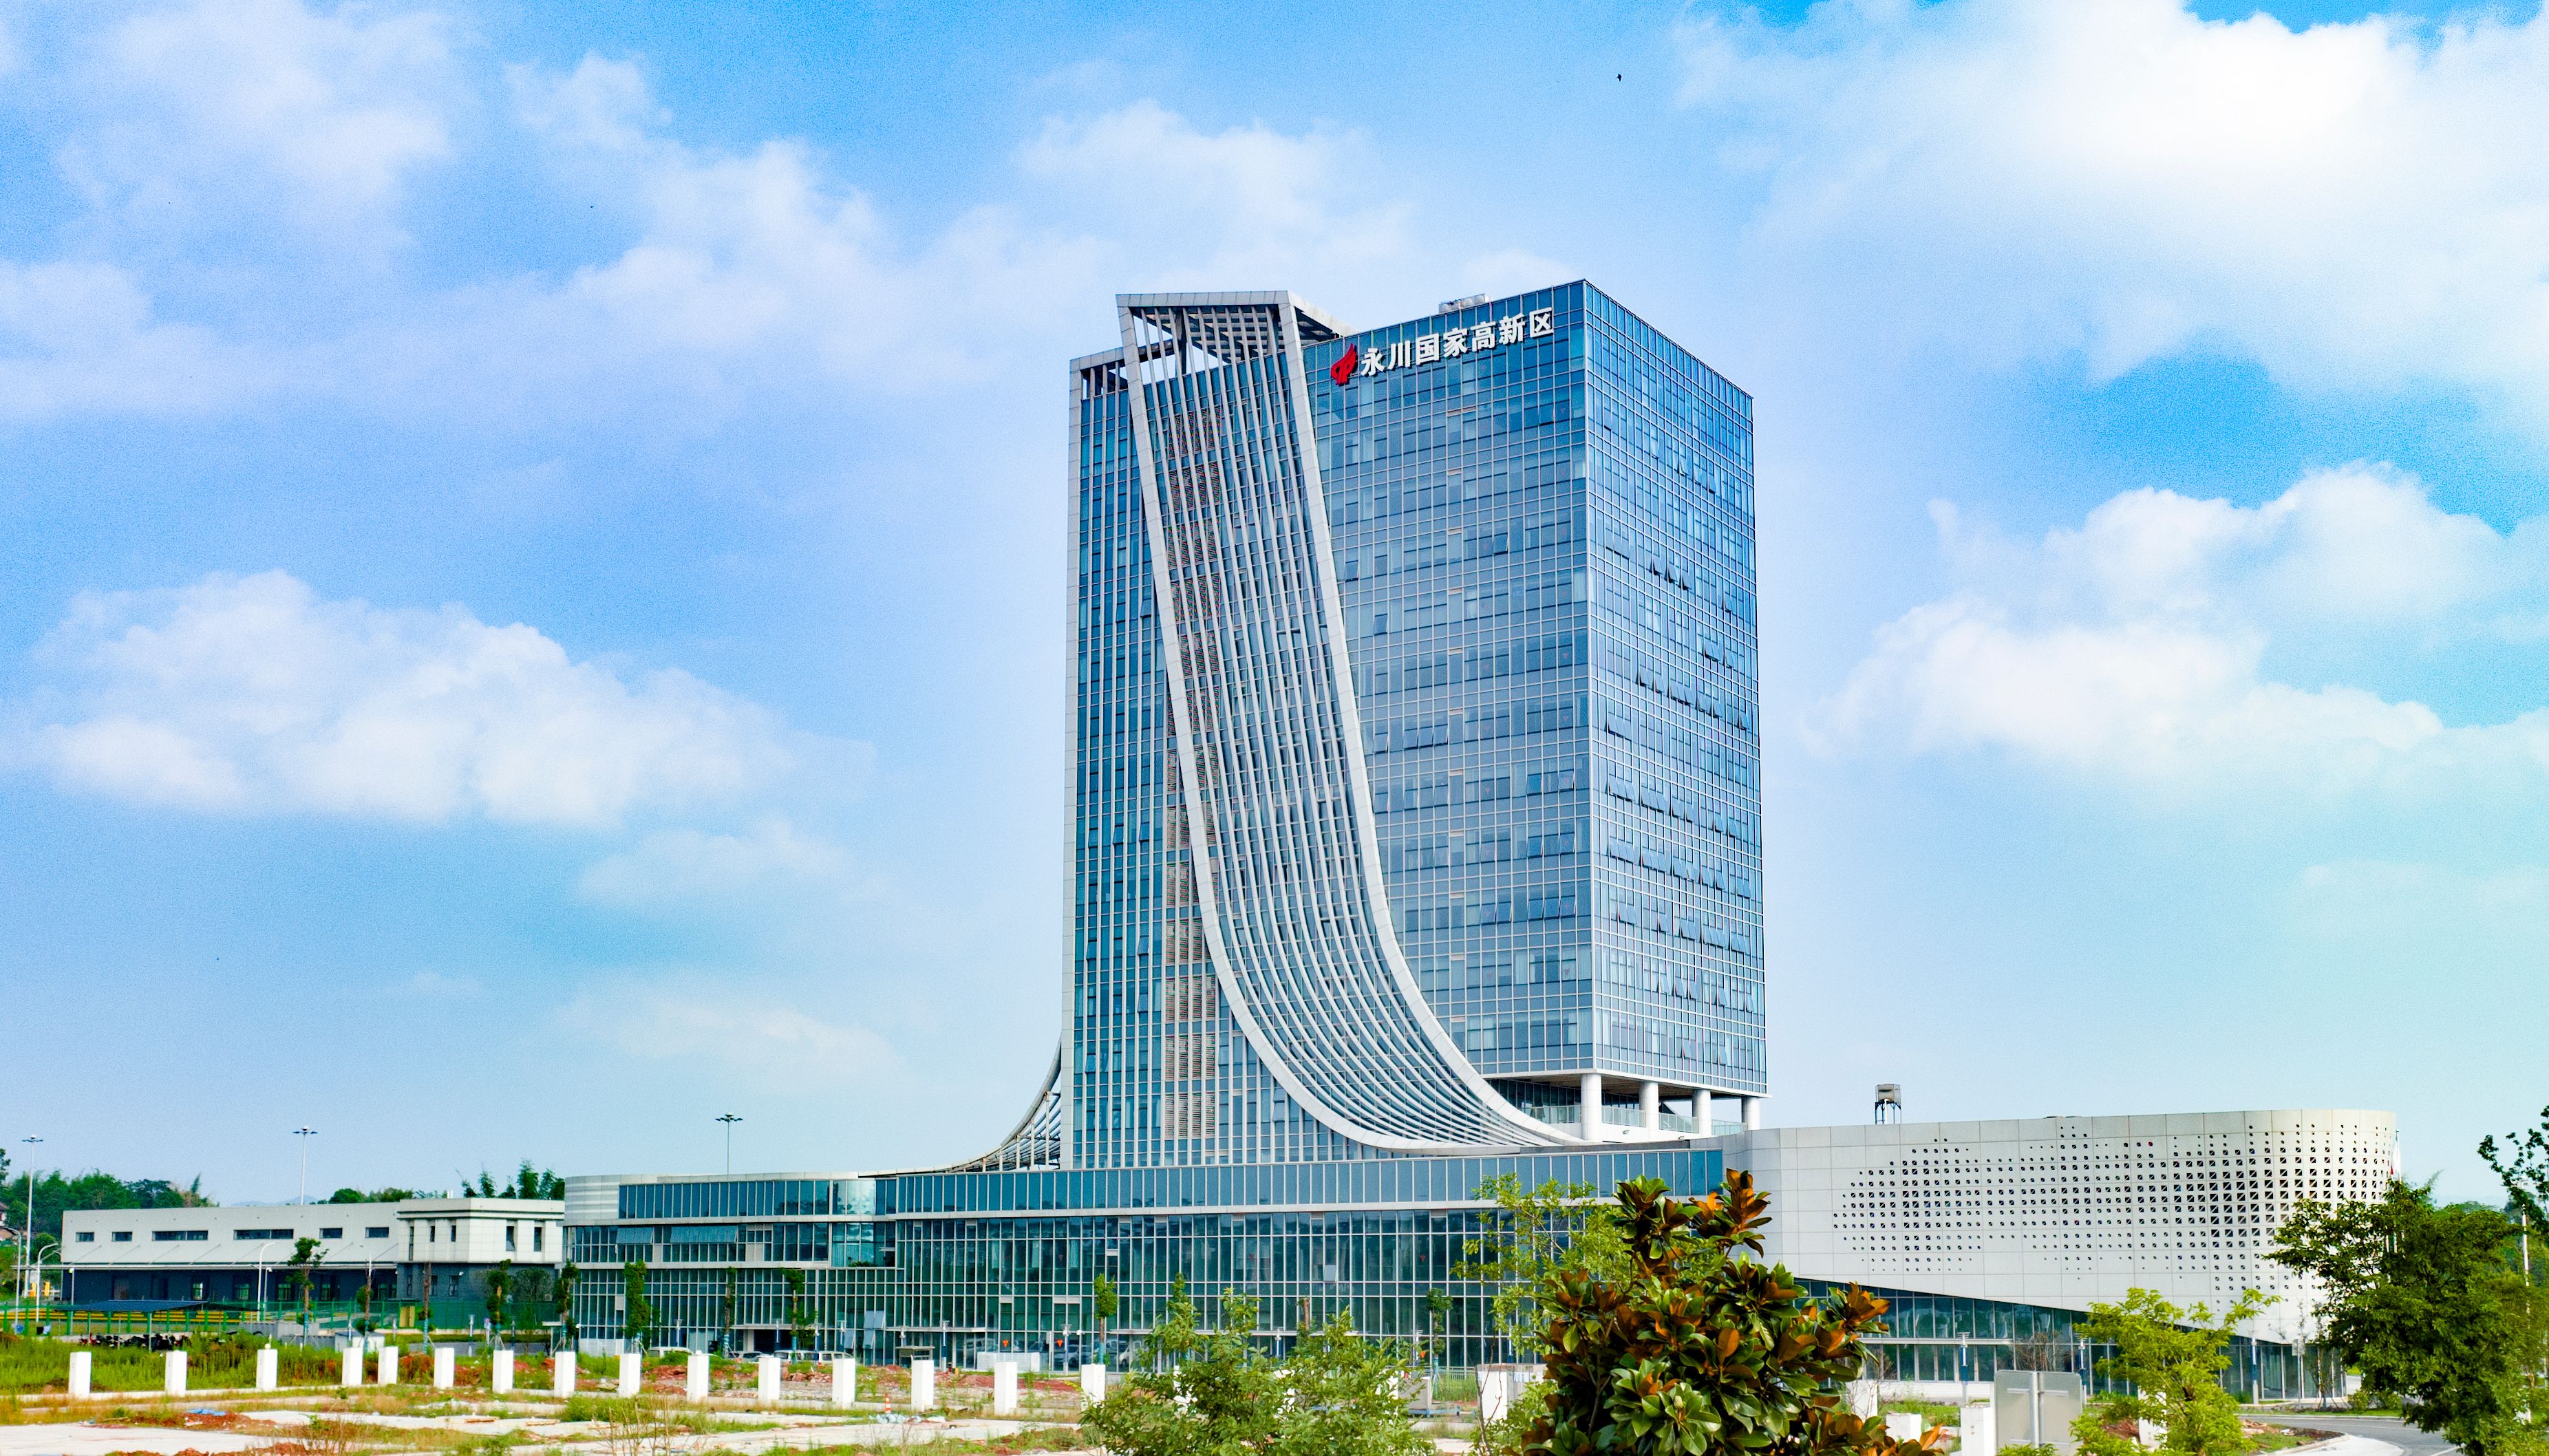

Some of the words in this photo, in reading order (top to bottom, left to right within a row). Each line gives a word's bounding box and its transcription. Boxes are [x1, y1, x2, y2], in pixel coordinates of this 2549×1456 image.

[1361, 308, 1553, 376] 永川国家高新区
